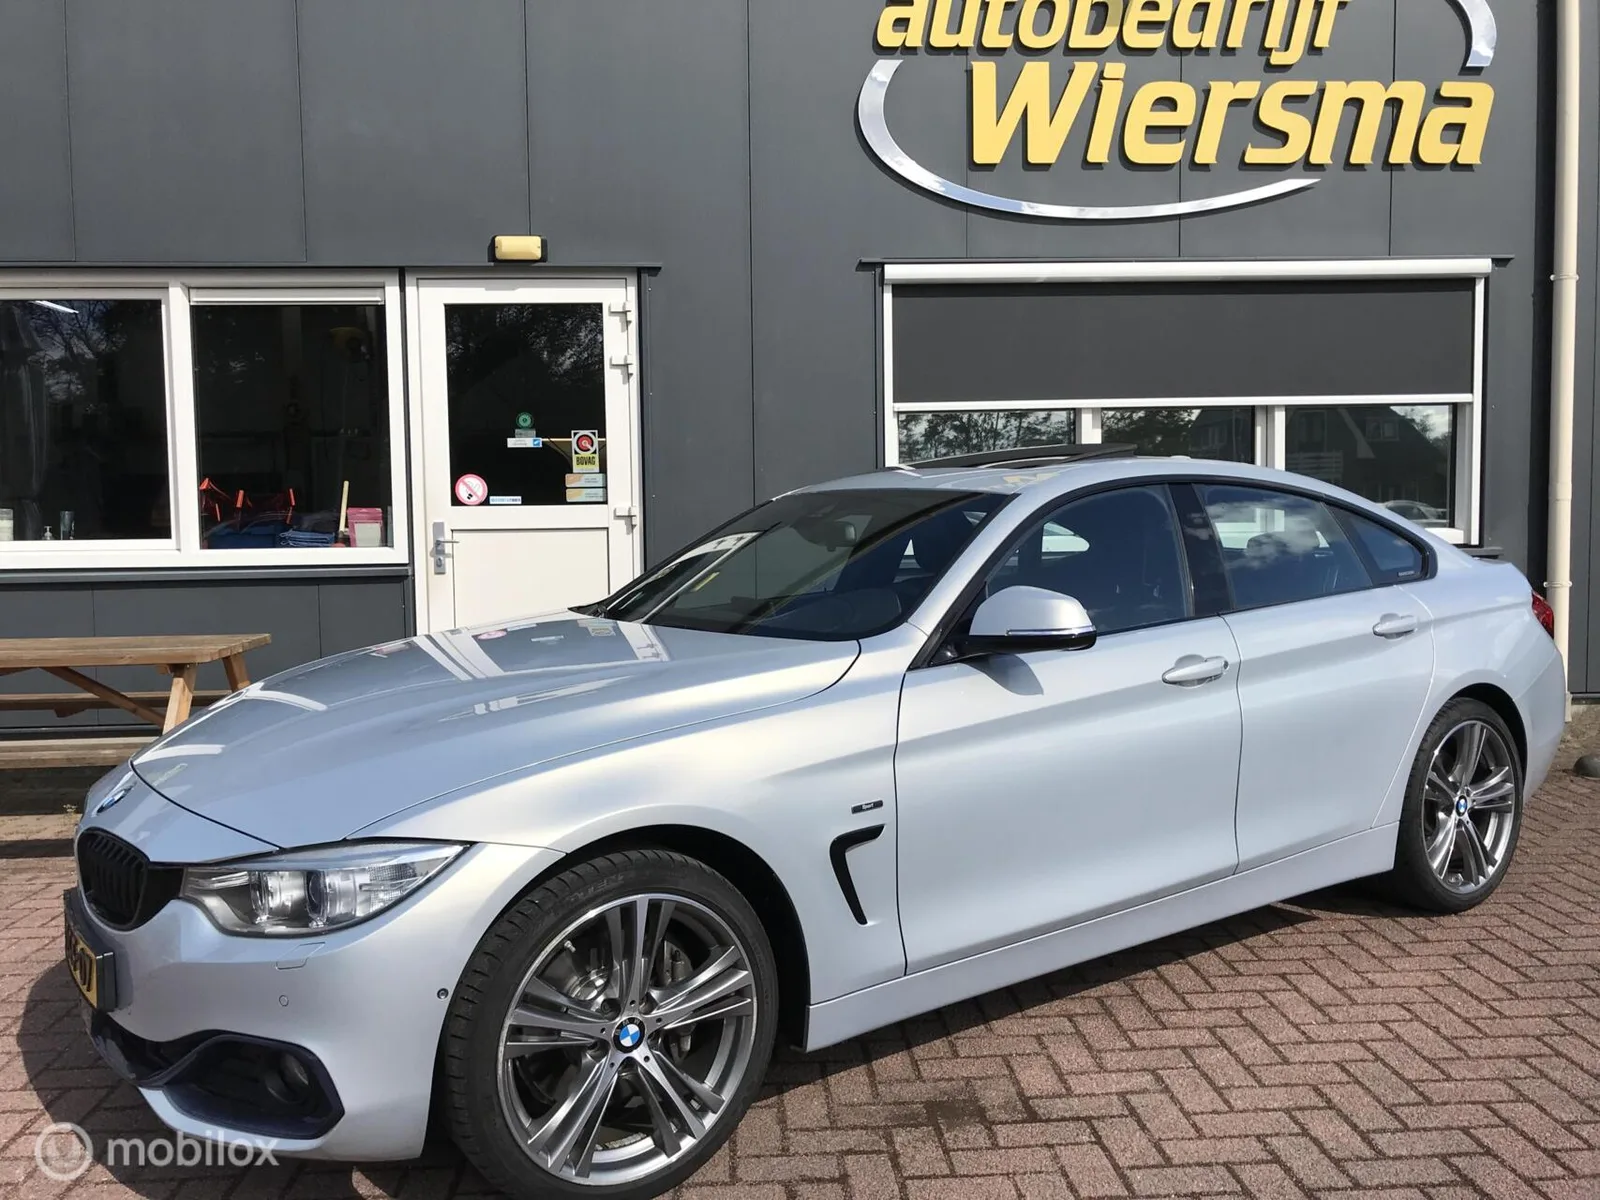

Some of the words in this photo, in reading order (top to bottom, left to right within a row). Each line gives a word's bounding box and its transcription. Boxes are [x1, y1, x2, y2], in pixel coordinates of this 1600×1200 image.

[877, 0, 1347, 65] autobedrijf
[972, 61, 1494, 165] Wiersma
[576, 456, 595, 466] BOVAG
